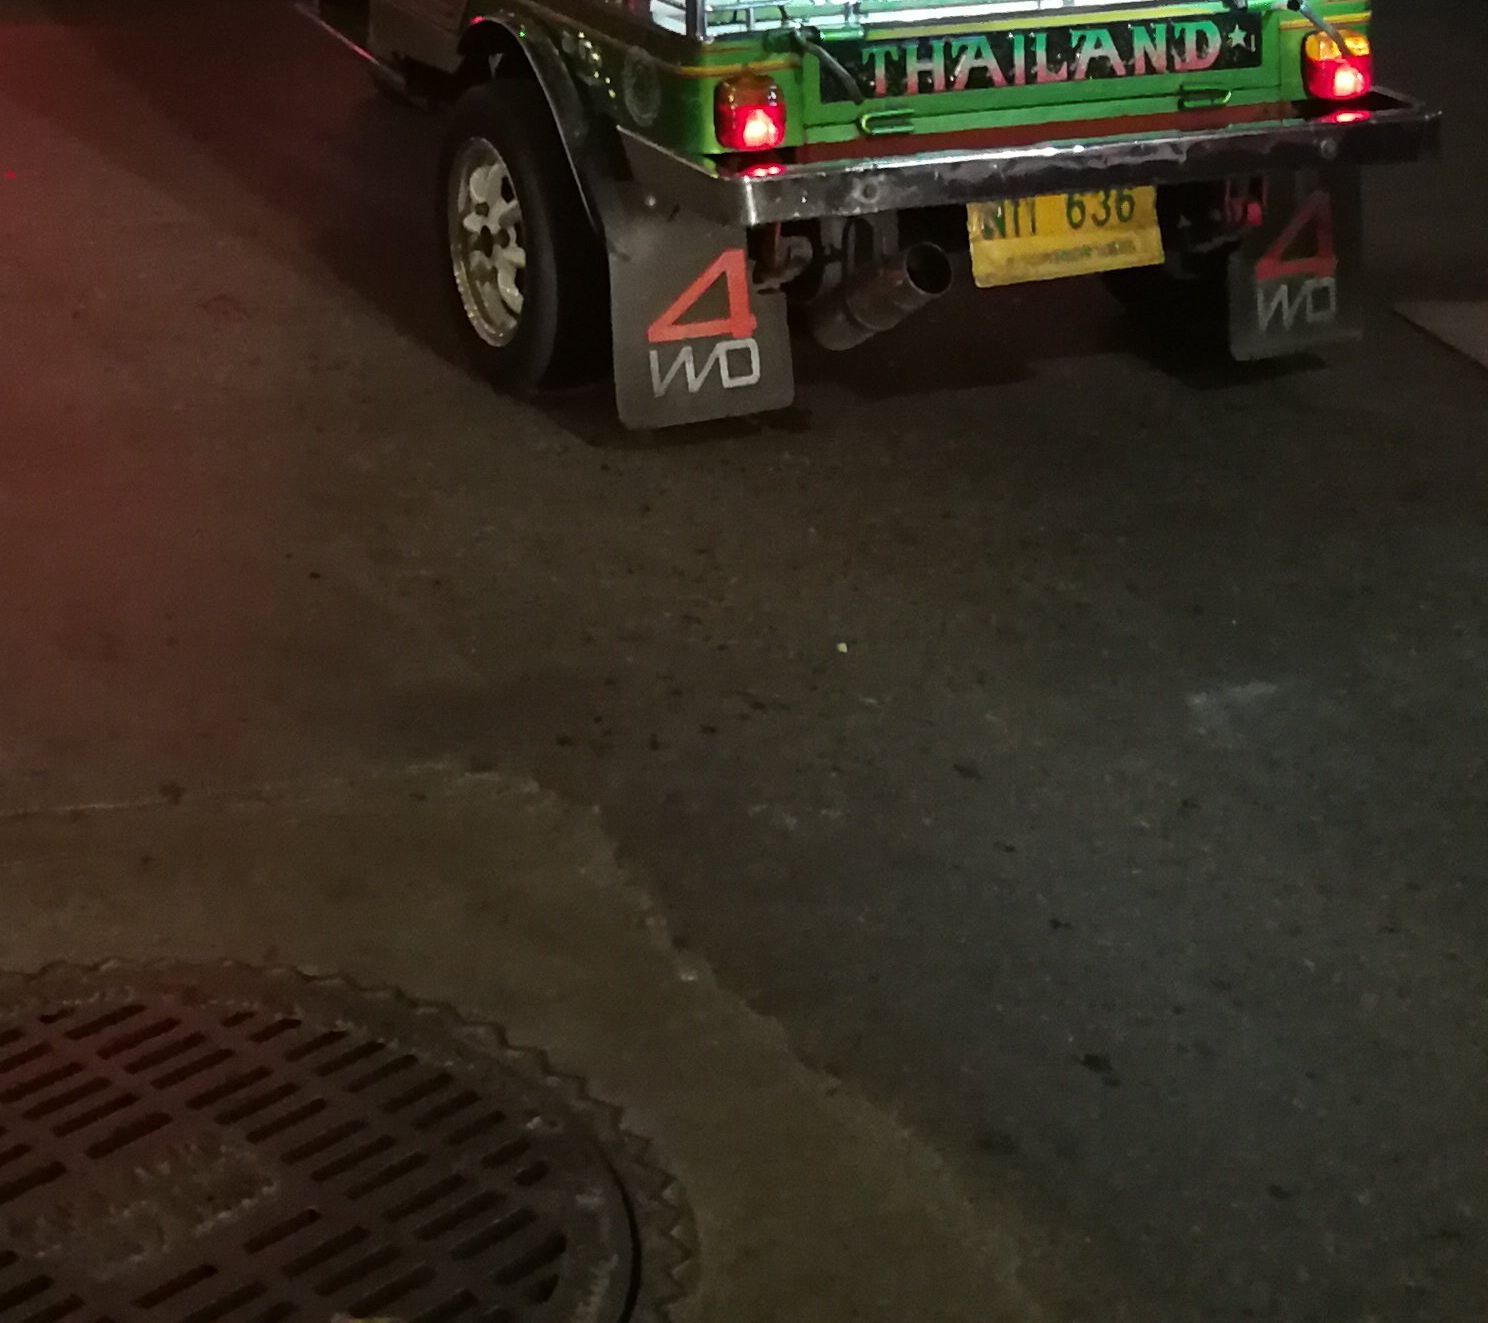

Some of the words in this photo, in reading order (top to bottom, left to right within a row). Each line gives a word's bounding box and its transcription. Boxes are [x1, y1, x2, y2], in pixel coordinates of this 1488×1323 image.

[860, 20, 1223, 98] THAILAND
[1255, 190, 1339, 281] 4
[646, 248, 758, 344] 4
